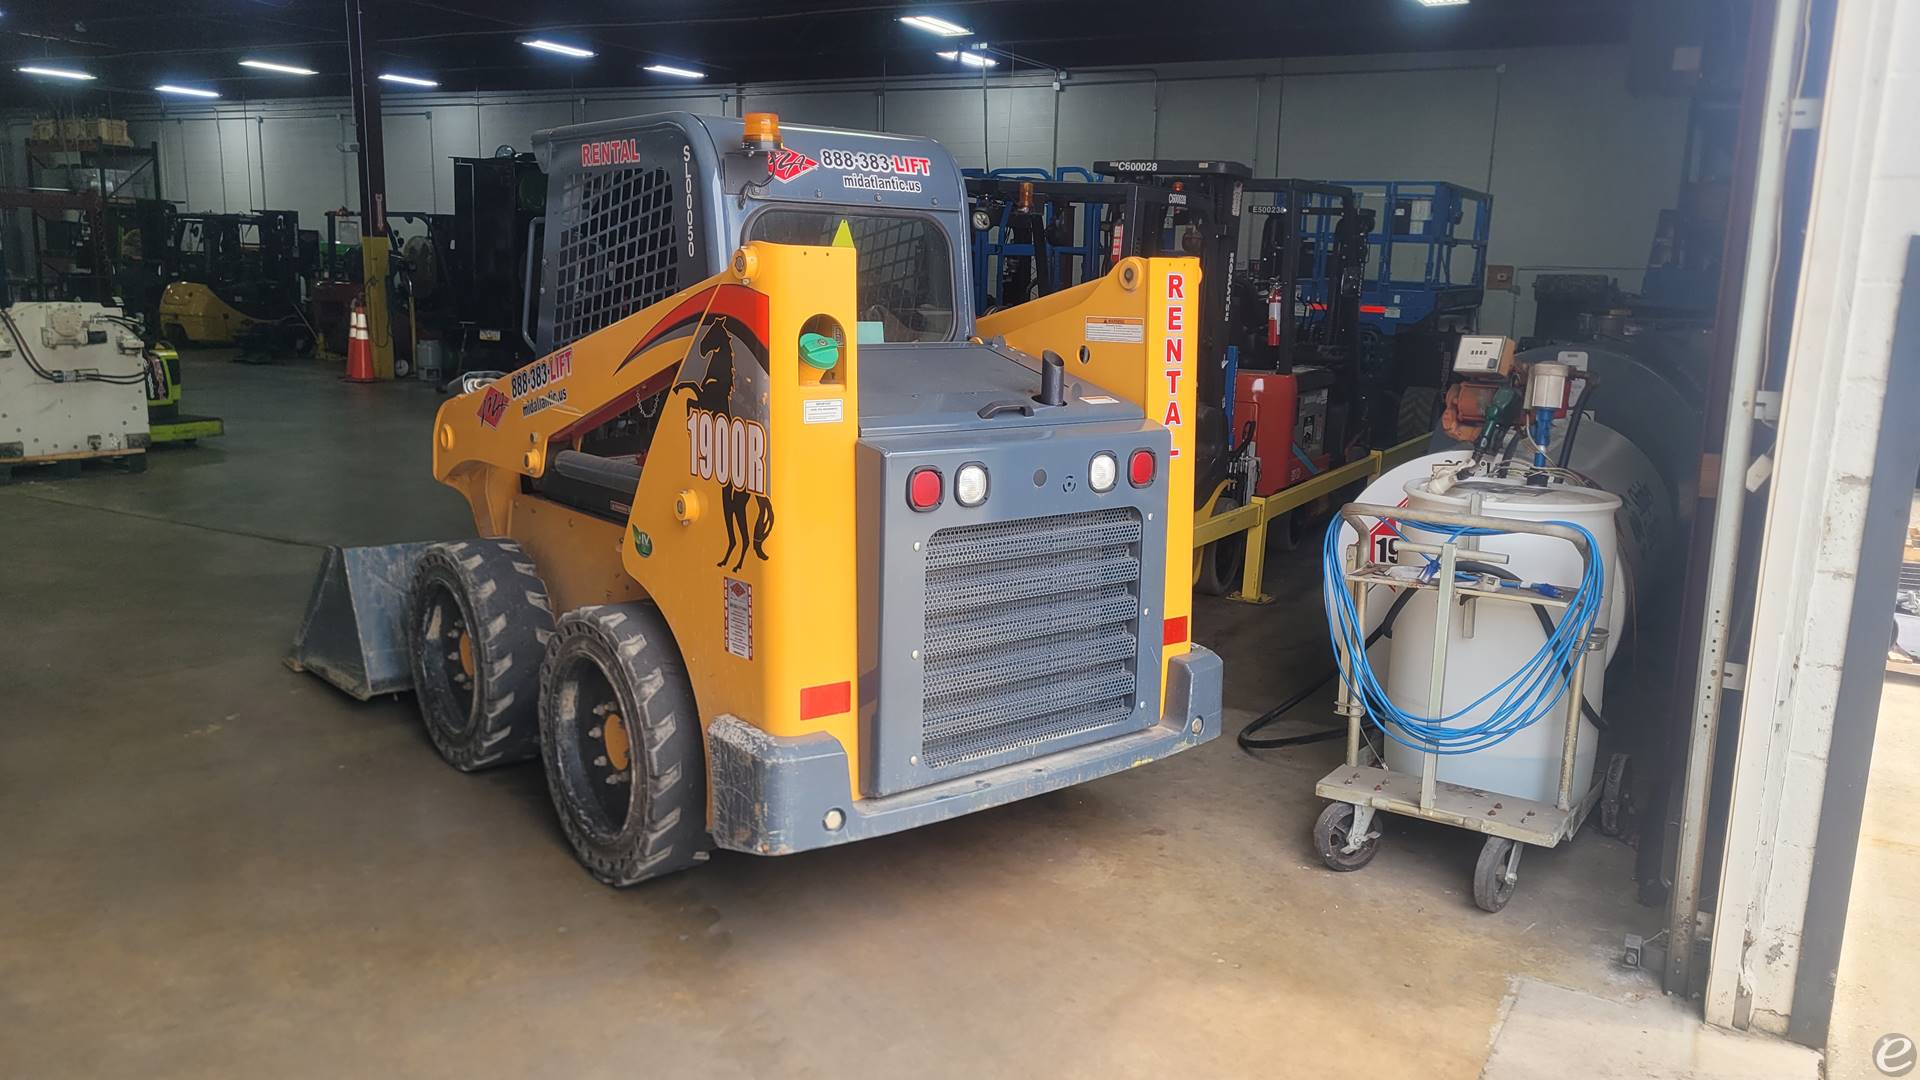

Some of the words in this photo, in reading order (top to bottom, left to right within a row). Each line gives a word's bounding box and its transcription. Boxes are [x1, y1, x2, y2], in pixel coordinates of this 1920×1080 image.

[581, 138, 640, 167] RENTAL
[1118, 161, 1158, 171] C600028
[683, 145, 695, 257] SL00050
[843, 174, 921, 193] midatlantic.us
[1164, 273, 1184, 457] RENTA
[687, 410, 767, 496] 1900R
